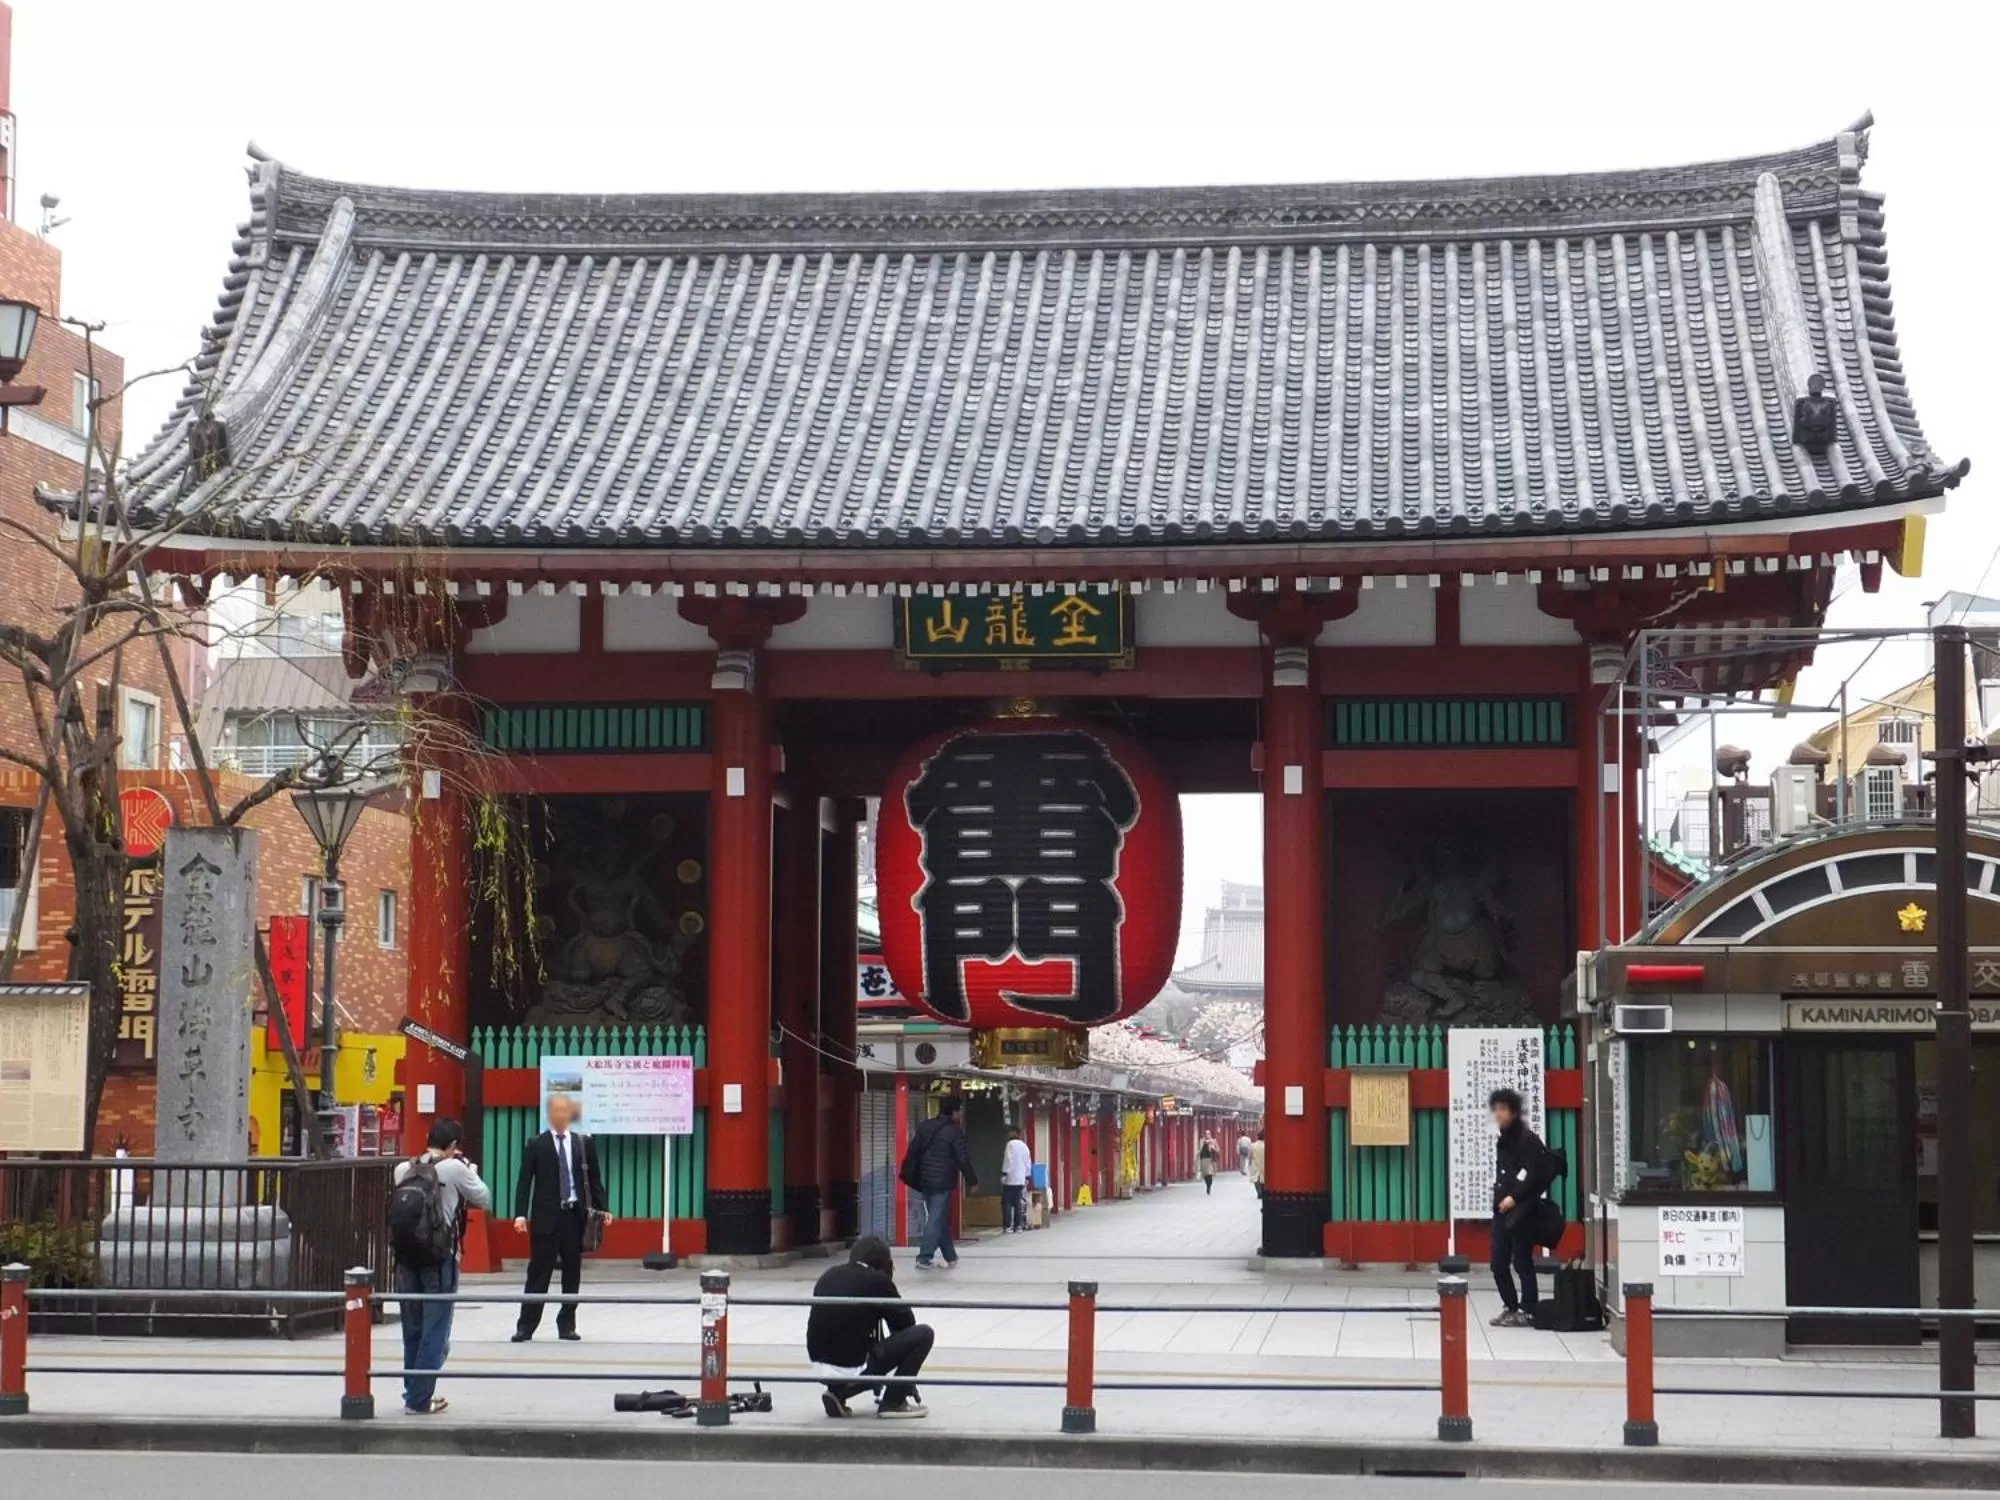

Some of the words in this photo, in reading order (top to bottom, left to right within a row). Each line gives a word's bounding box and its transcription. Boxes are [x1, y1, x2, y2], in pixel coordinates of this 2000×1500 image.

[904, 729, 1142, 1024] 雷門
[117, 868, 157, 1060] ホテル雷門
[1902, 960, 2000, 988] 雷交
[1802, 1008, 1937, 1023] KAMINARIMON
[1663, 1231, 1686, 1244] 死亡
[1663, 1254, 1686, 1266] 負傷
[1707, 1254, 1737, 1268] 127
